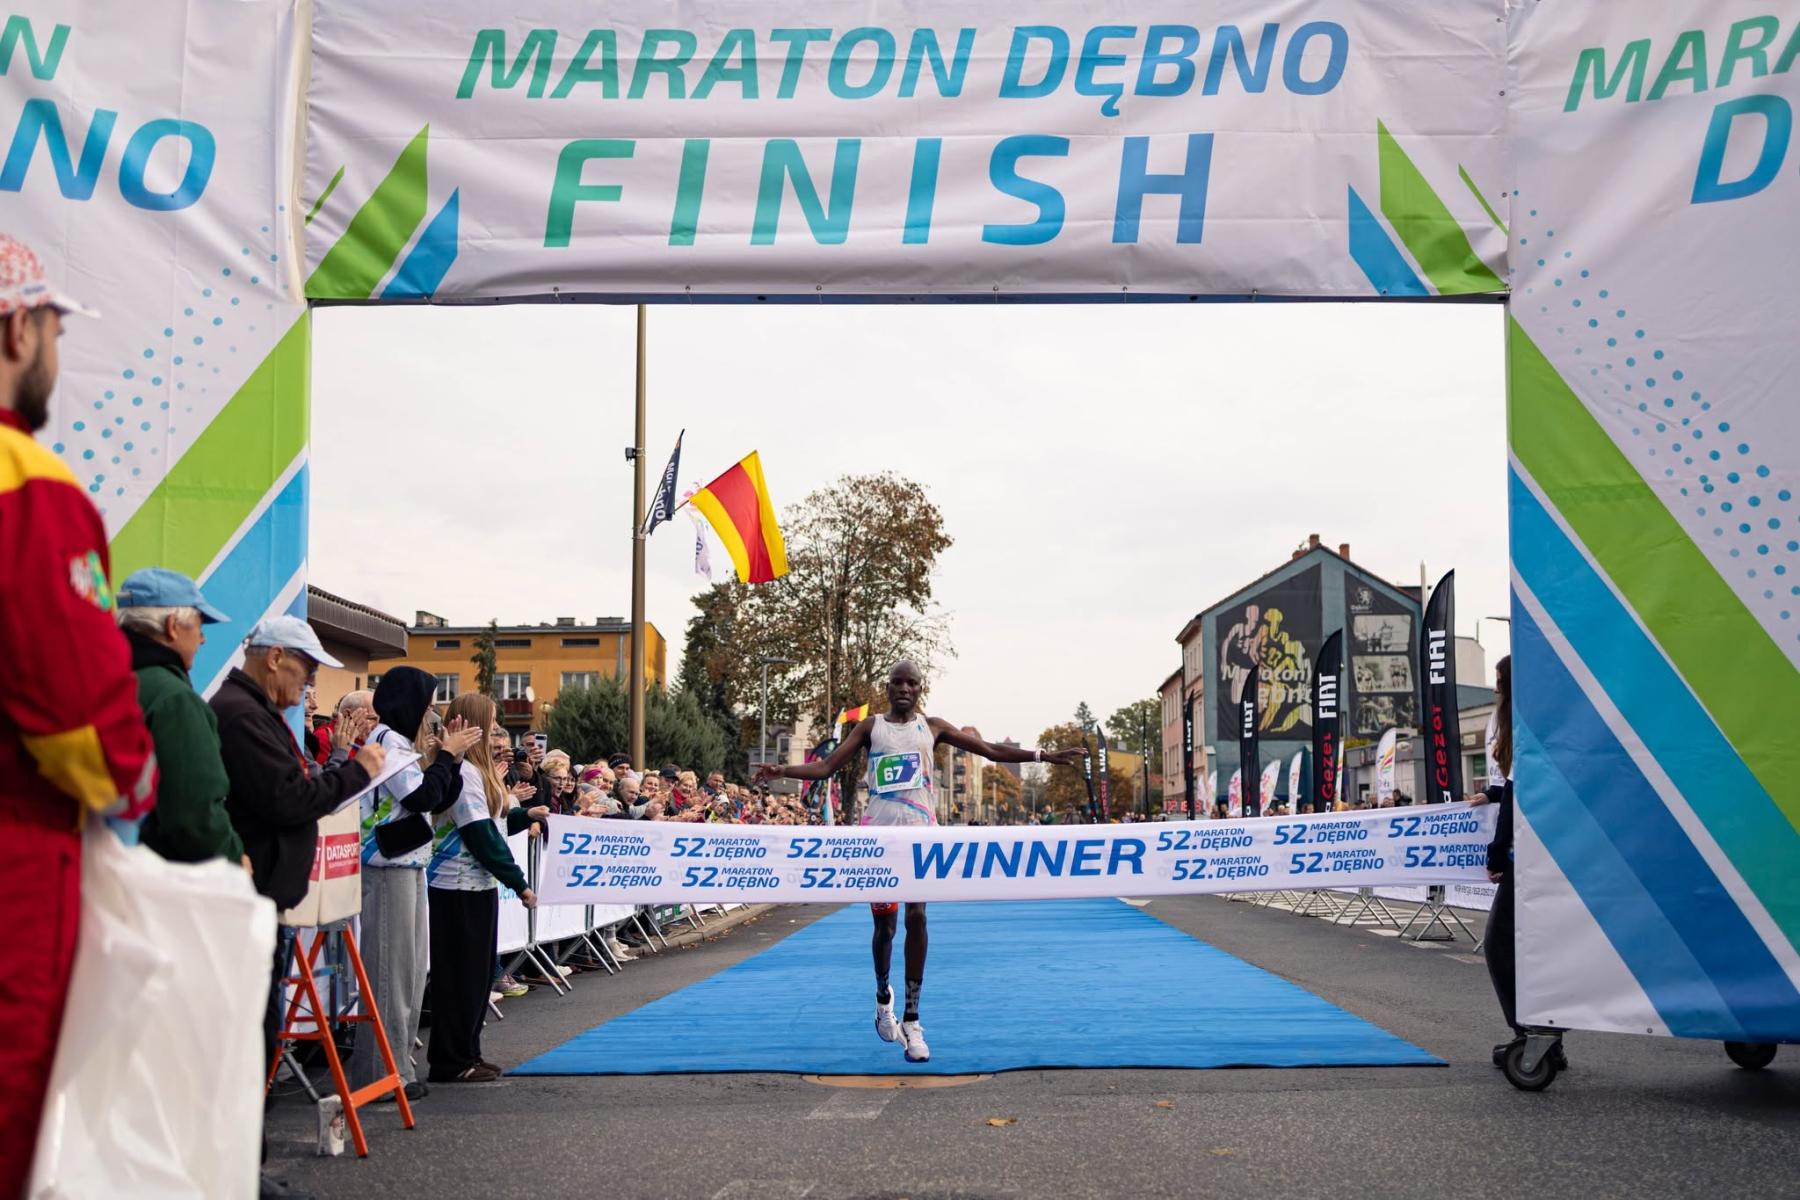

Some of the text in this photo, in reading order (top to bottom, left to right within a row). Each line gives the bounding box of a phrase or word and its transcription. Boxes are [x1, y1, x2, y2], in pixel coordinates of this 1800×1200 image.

[456, 21, 1349, 117] MARATON DĘBNO
[1563, 15, 1800, 113] MAR
[544, 133, 1214, 247] FINISH
[1429, 629, 1445, 684] FIAT
[1319, 673, 1337, 718] FIAT
[884, 765, 904, 781] 67
[1424, 811, 1473, 824] MARATON
[1193, 827, 1245, 837] MARATON
[1310, 821, 1361, 831] MARATON
[1387, 817, 1427, 838] 52.
[1429, 821, 1479, 838] DĘBNO
[595, 835, 645, 844] MARATON
[708, 838, 760, 846] MARATON
[826, 838, 878, 846] MARATON
[1156, 830, 1198, 851] 52.
[1200, 835, 1253, 851] DĘBNO
[1273, 824, 1313, 846] 52.
[1316, 829, 1368, 845] DĘBNO
[559, 833, 597, 856] 52.
[600, 844, 651, 858] DĘBNO
[670, 837, 711, 858] 52.
[786, 838, 828, 858] 52.
[714, 847, 767, 861] DĘBNO
[831, 846, 885, 861] DĘBNO
[912, 838, 1147, 880] WINNER
[1209, 855, 1261, 865] MARATON
[1326, 849, 1376, 859] MARATON
[1404, 845, 1444, 868] 52.
[1446, 853, 1488, 869] DĘBN
[606, 866, 657, 874] MARATON
[721, 867, 773, 875] MARATON
[839, 867, 892, 875] MARATON
[1171, 859, 1213, 880] 52.
[1288, 852, 1329, 874] 52.
[1332, 858, 1384, 873] DĘBNO
[566, 865, 606, 887] 52.
[682, 867, 723, 887] 52.
[800, 867, 842, 888] 52.
[1217, 864, 1269, 880] DĘBNO
[609, 875, 663, 890] DĘBNO
[727, 876, 780, 890] DĘBNO
[845, 876, 899, 890] DĘBNO
